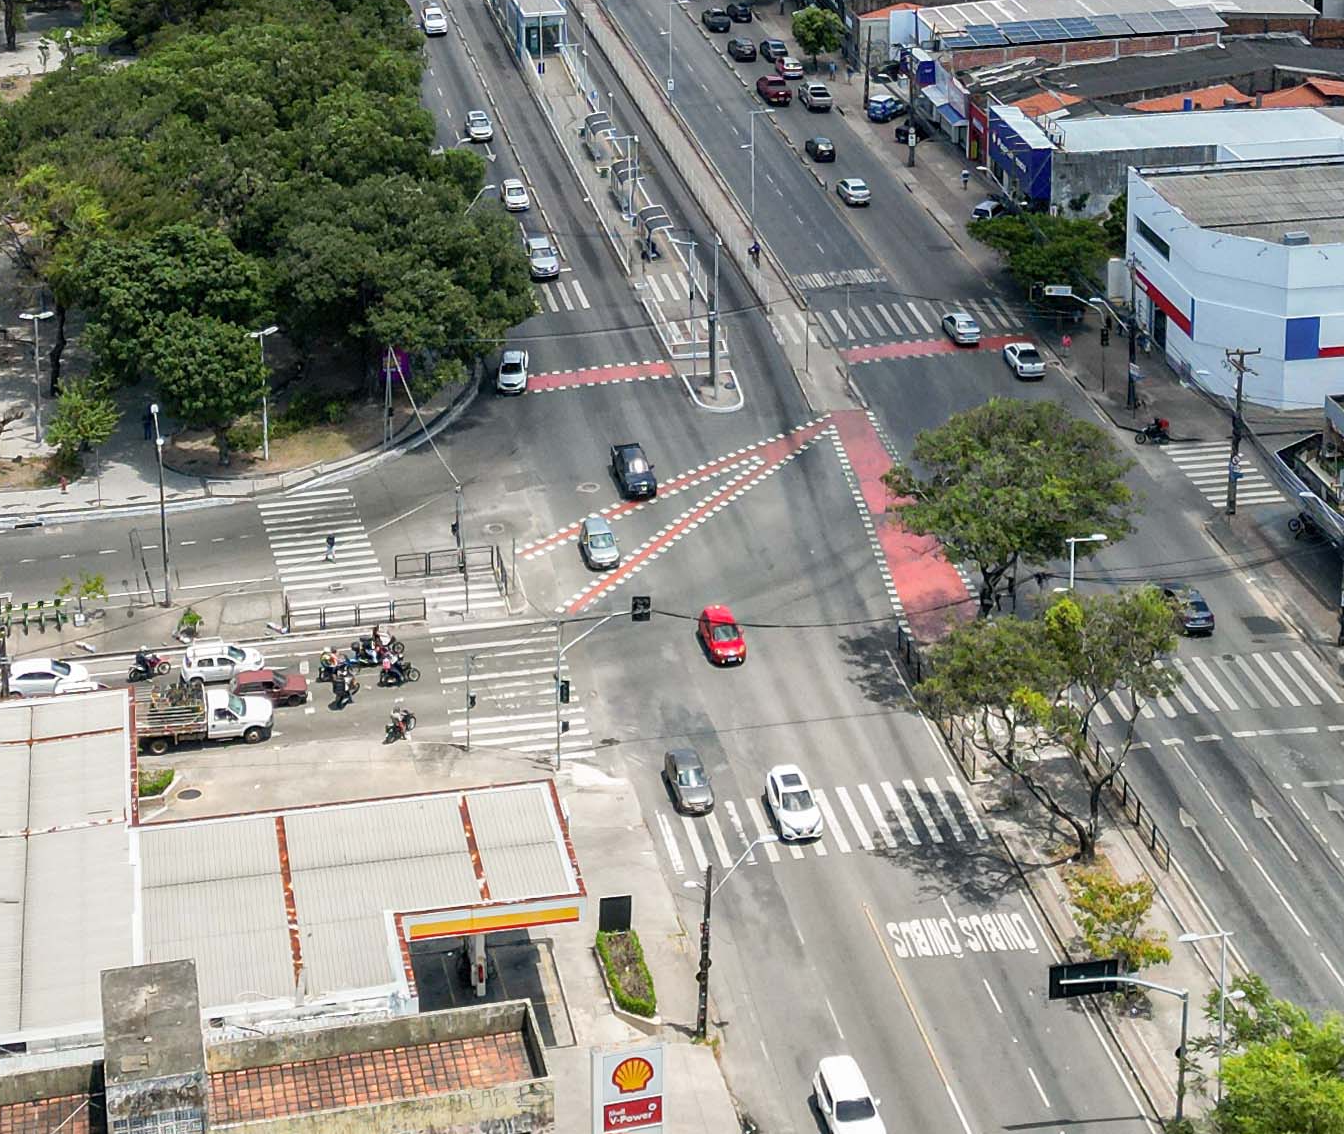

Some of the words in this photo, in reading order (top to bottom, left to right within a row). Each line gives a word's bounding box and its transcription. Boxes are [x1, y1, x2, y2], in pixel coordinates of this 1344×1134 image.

[886, 917, 964, 959] ÔNIBUS
[957, 912, 1040, 954] ÔNIBUS
[609, 1111, 654, 1125] V-Power
